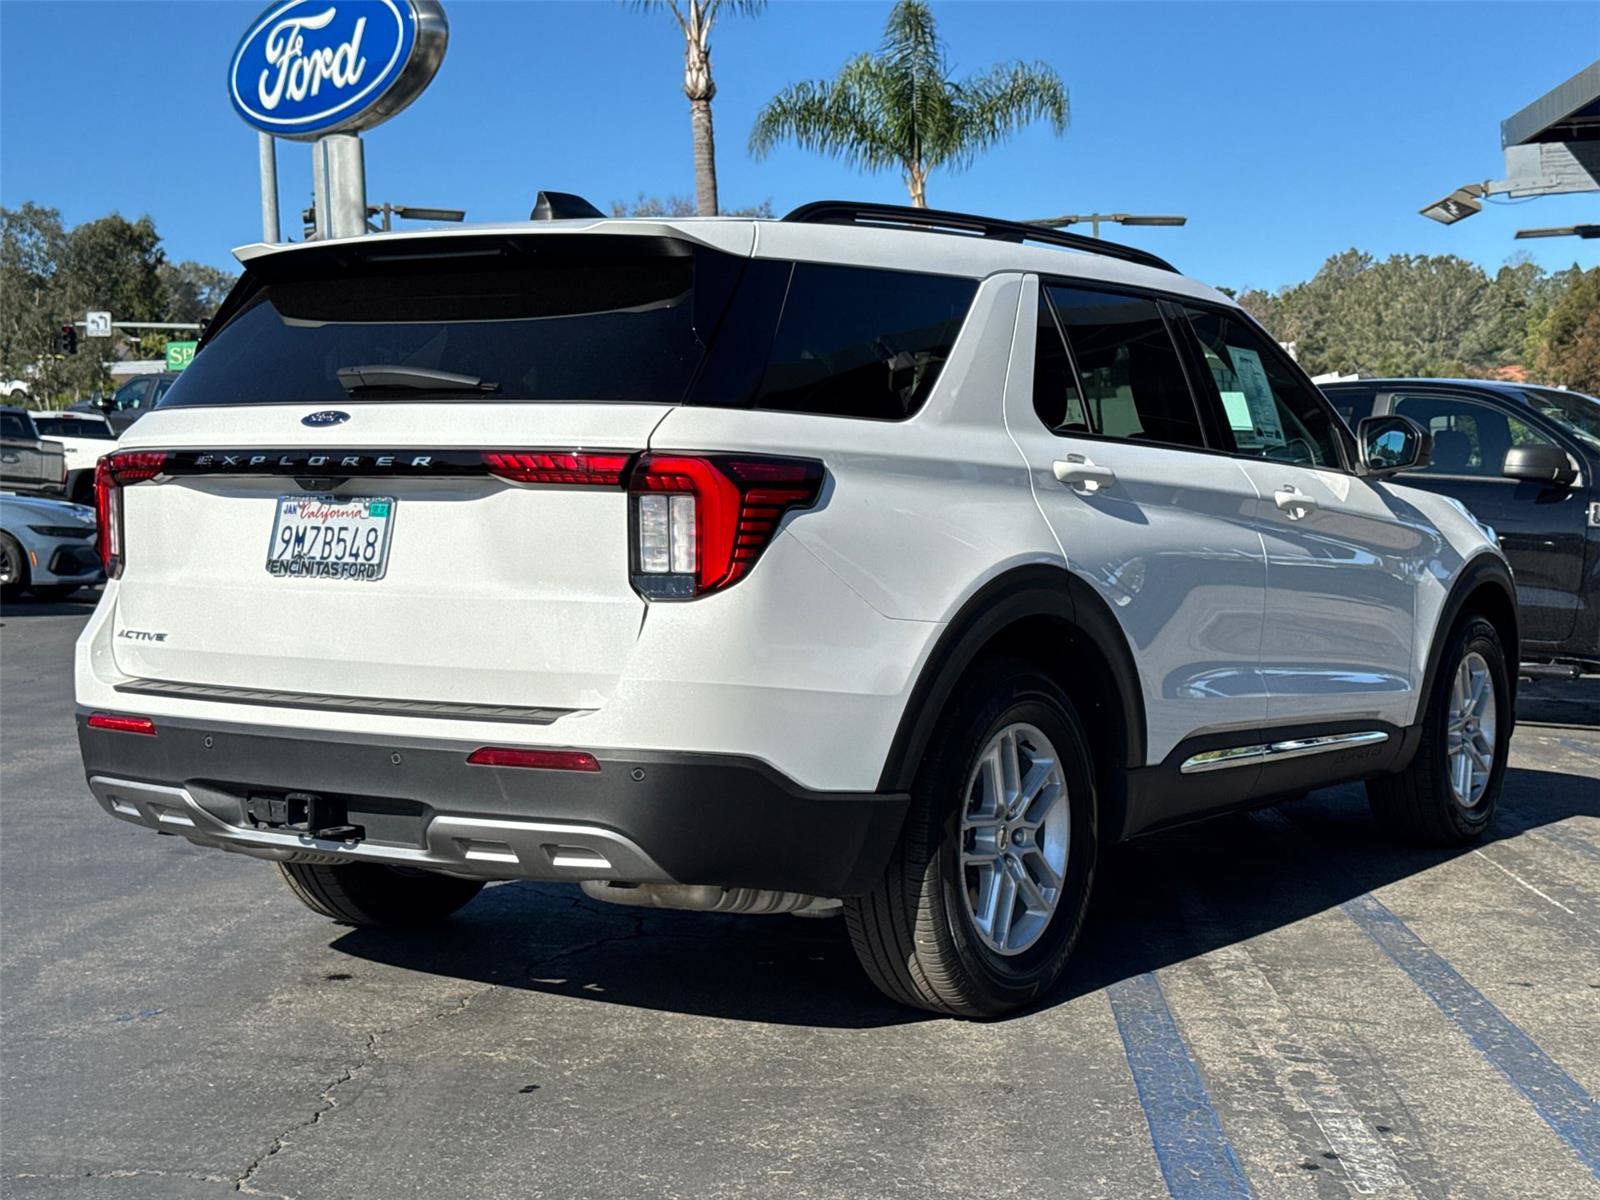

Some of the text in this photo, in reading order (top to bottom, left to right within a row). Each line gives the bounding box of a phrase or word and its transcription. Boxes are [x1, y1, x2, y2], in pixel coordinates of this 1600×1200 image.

[258, 6, 367, 110] Ford
[194, 454, 432, 467] EXPLORER
[299, 501, 368, 524] California
[278, 525, 378, 562] 9MZB548
[270, 559, 375, 578] ENCINITAS FORD
[117, 629, 168, 642] ACTIVE
